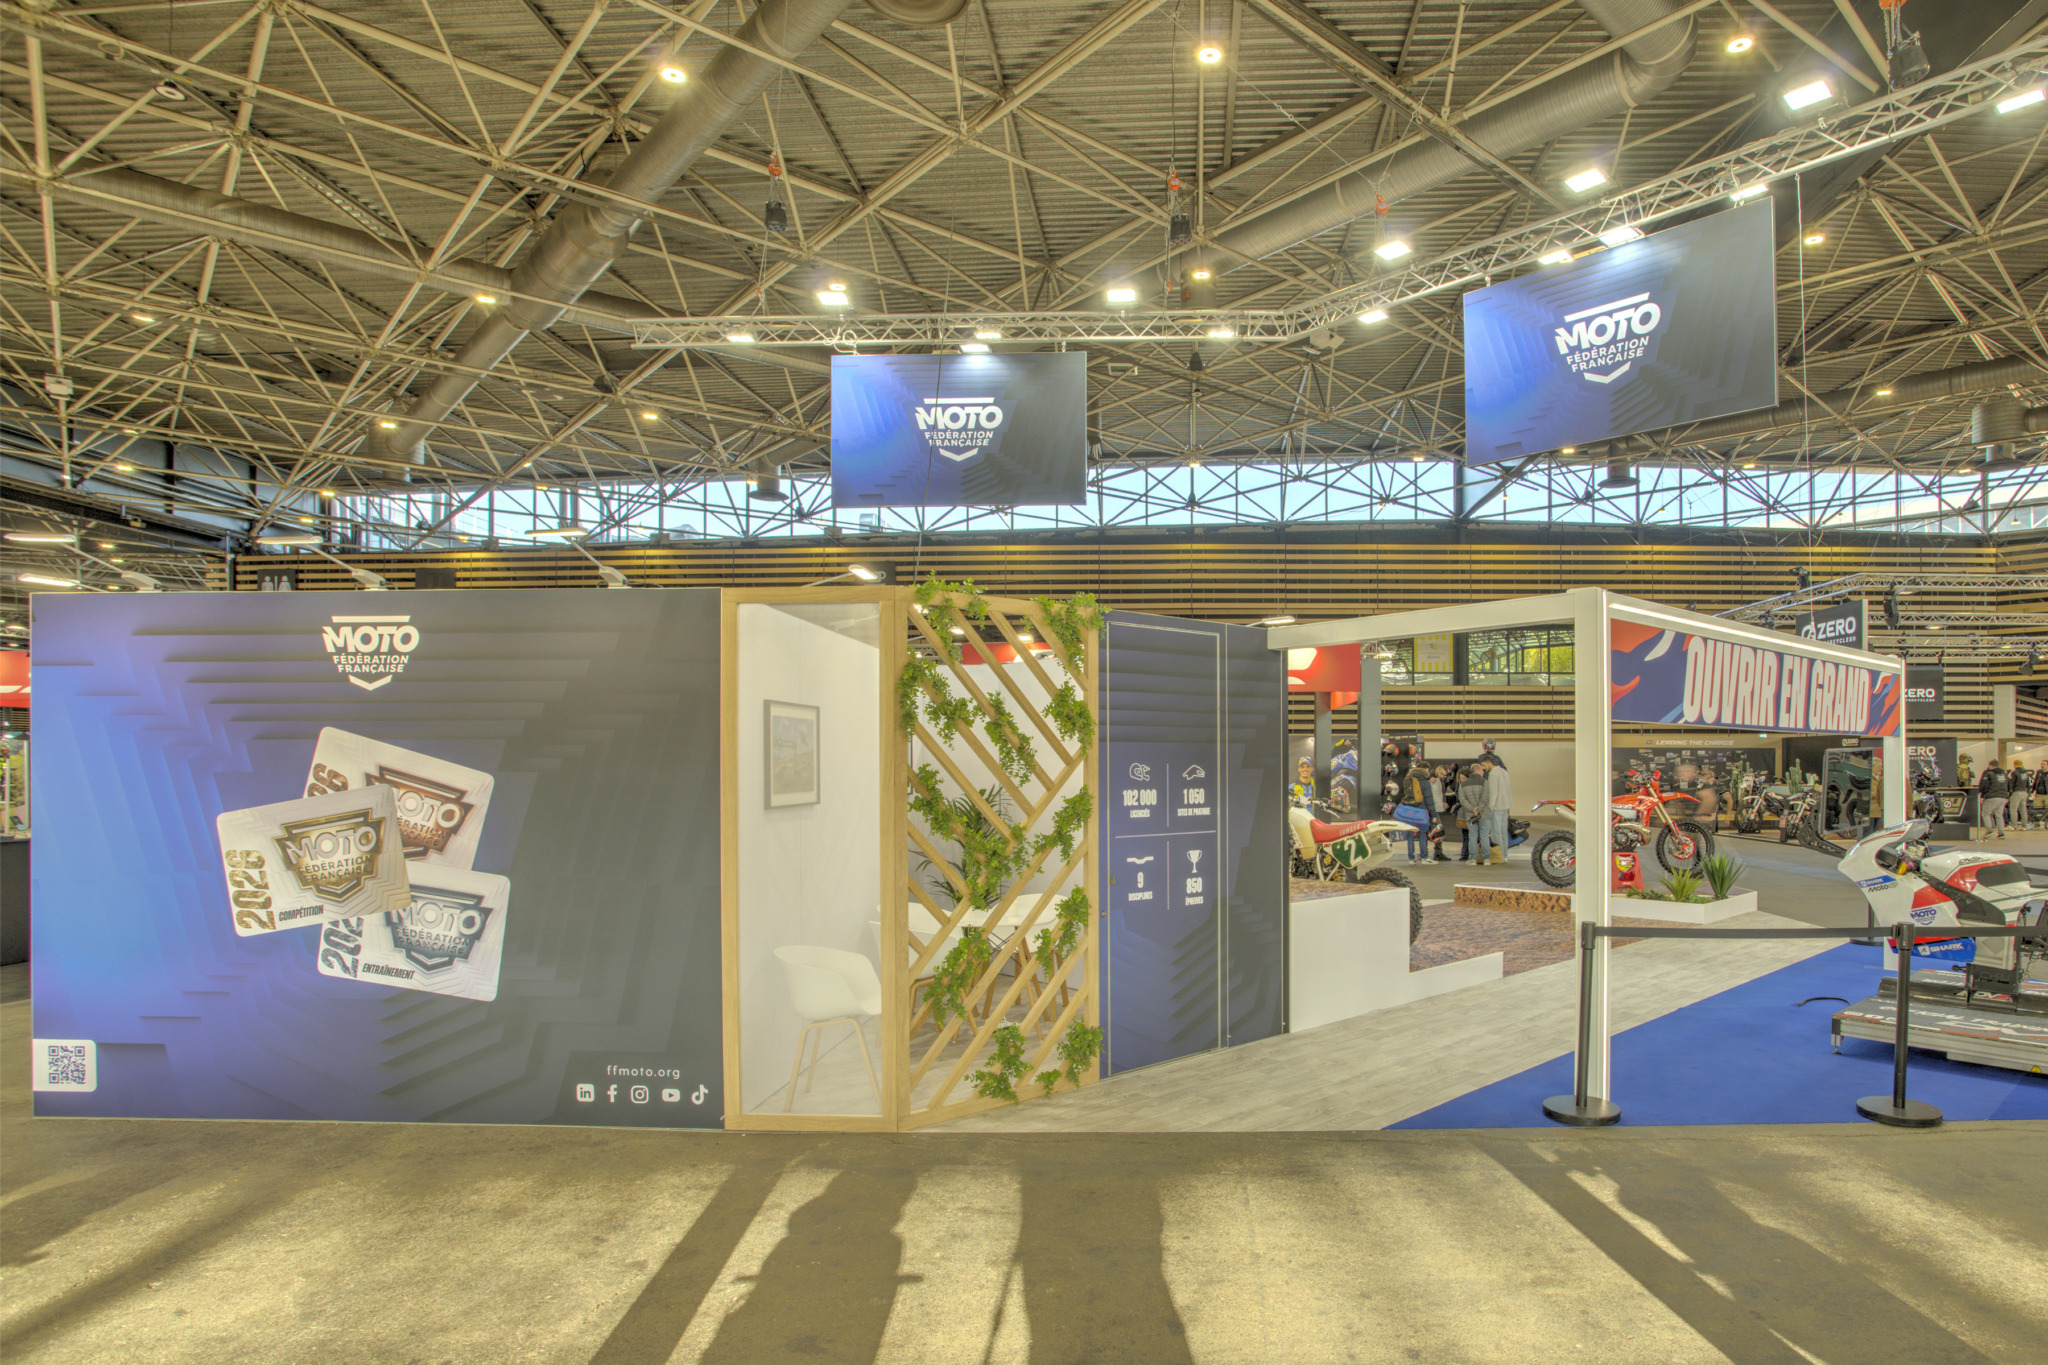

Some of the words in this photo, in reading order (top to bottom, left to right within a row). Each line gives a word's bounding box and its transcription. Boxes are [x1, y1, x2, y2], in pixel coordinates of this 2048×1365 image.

[1554, 302, 1661, 355] MOTO
[1566, 336, 1650, 365] FÉDÉRATION
[1571, 347, 1645, 373] FRANÇAISE
[915, 405, 1003, 430] MOTO
[925, 429, 994, 440] FÉDÉRATION
[929, 438, 990, 448] FRANÇAISE
[1817, 616, 1857, 639] ZERO
[322, 625, 420, 653] MOTO
[332, 652, 409, 664] FÉDÉRATION
[337, 664, 404, 674] FRANÇAISE
[1683, 635, 1779, 727] OUVRIR
[1778, 654, 1811, 729] EN
[1809, 659, 1871, 732] GRAND
[1908, 745, 1937, 756] ERO
[1122, 789, 1139, 806] 102
[1139, 788, 1157, 806] 000
[1188, 788, 1205, 804] 050
[394, 787, 461, 829] OTO
[397, 815, 448, 839] ÉRATION
[285, 826, 378, 865] MOTO
[1344, 838, 1363, 867] 2
[298, 854, 372, 874] FÉDÉRATION
[304, 864, 368, 882] FRANÇAISE
[225, 849, 277, 930] 2026
[1137, 872, 1144, 889] 9
[1186, 877, 1203, 894] 850
[278, 904, 324, 922] COMPÉTITION
[391, 899, 481, 936] MOTO
[1910, 908, 1936, 919] MOTO
[396, 925, 471, 948] FÉDÉRATION
[399, 936, 468, 955] FRANÇAISE
[320, 916, 364, 979] 202
[1930, 943, 1964, 952] SHARK
[362, 963, 415, 980] ENTRAÎNEMENT
[606, 1064, 680, 1080] ffmoto.org
